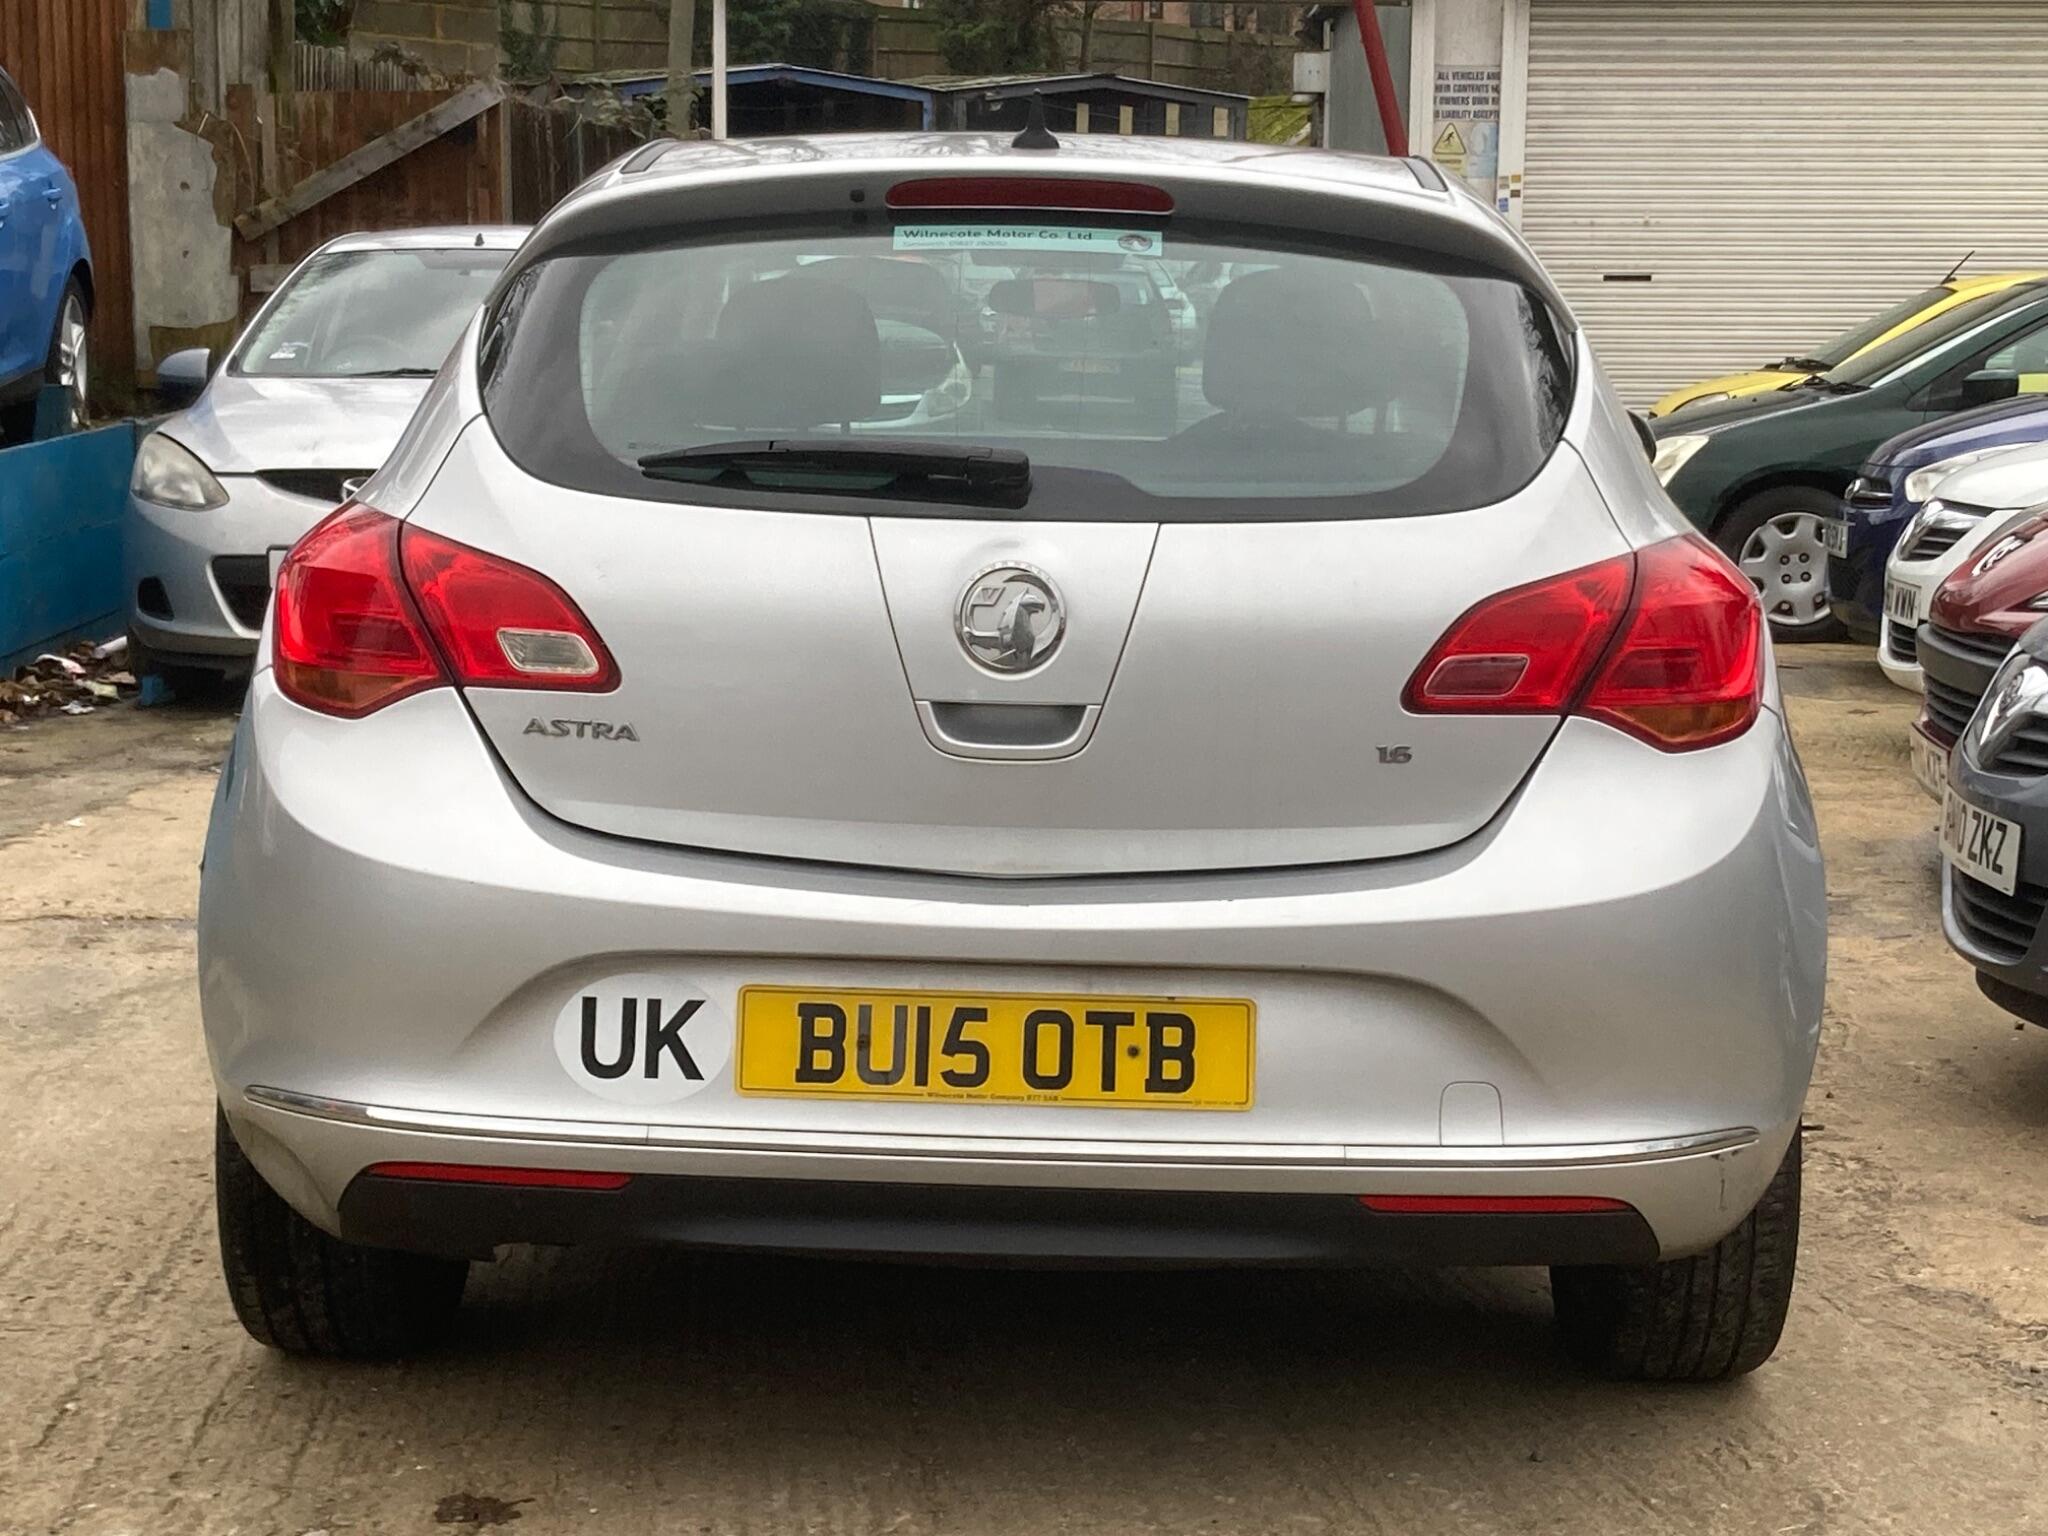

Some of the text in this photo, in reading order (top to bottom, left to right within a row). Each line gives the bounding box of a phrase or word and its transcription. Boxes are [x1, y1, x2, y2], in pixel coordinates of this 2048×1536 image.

[1437, 71, 1450, 80] ALL
[1452, 71, 1485, 81] VEHICLES
[1453, 84, 1489, 93] CONTENTS
[1439, 96, 1470, 106] OWNERS
[1472, 96, 1489, 106] OWN
[1441, 110, 1471, 119] LIABILITY
[903, 229, 982, 239] Wilnecote
[987, 229, 1035, 239] Motor
[1067, 231, 1092, 241] Ltd
[523, 718, 640, 741] ASTRA
[1967, 810, 2008, 876] ZKZ
[581, 996, 706, 1081] UK
[795, 1002, 1196, 1094] BU15 OTB
